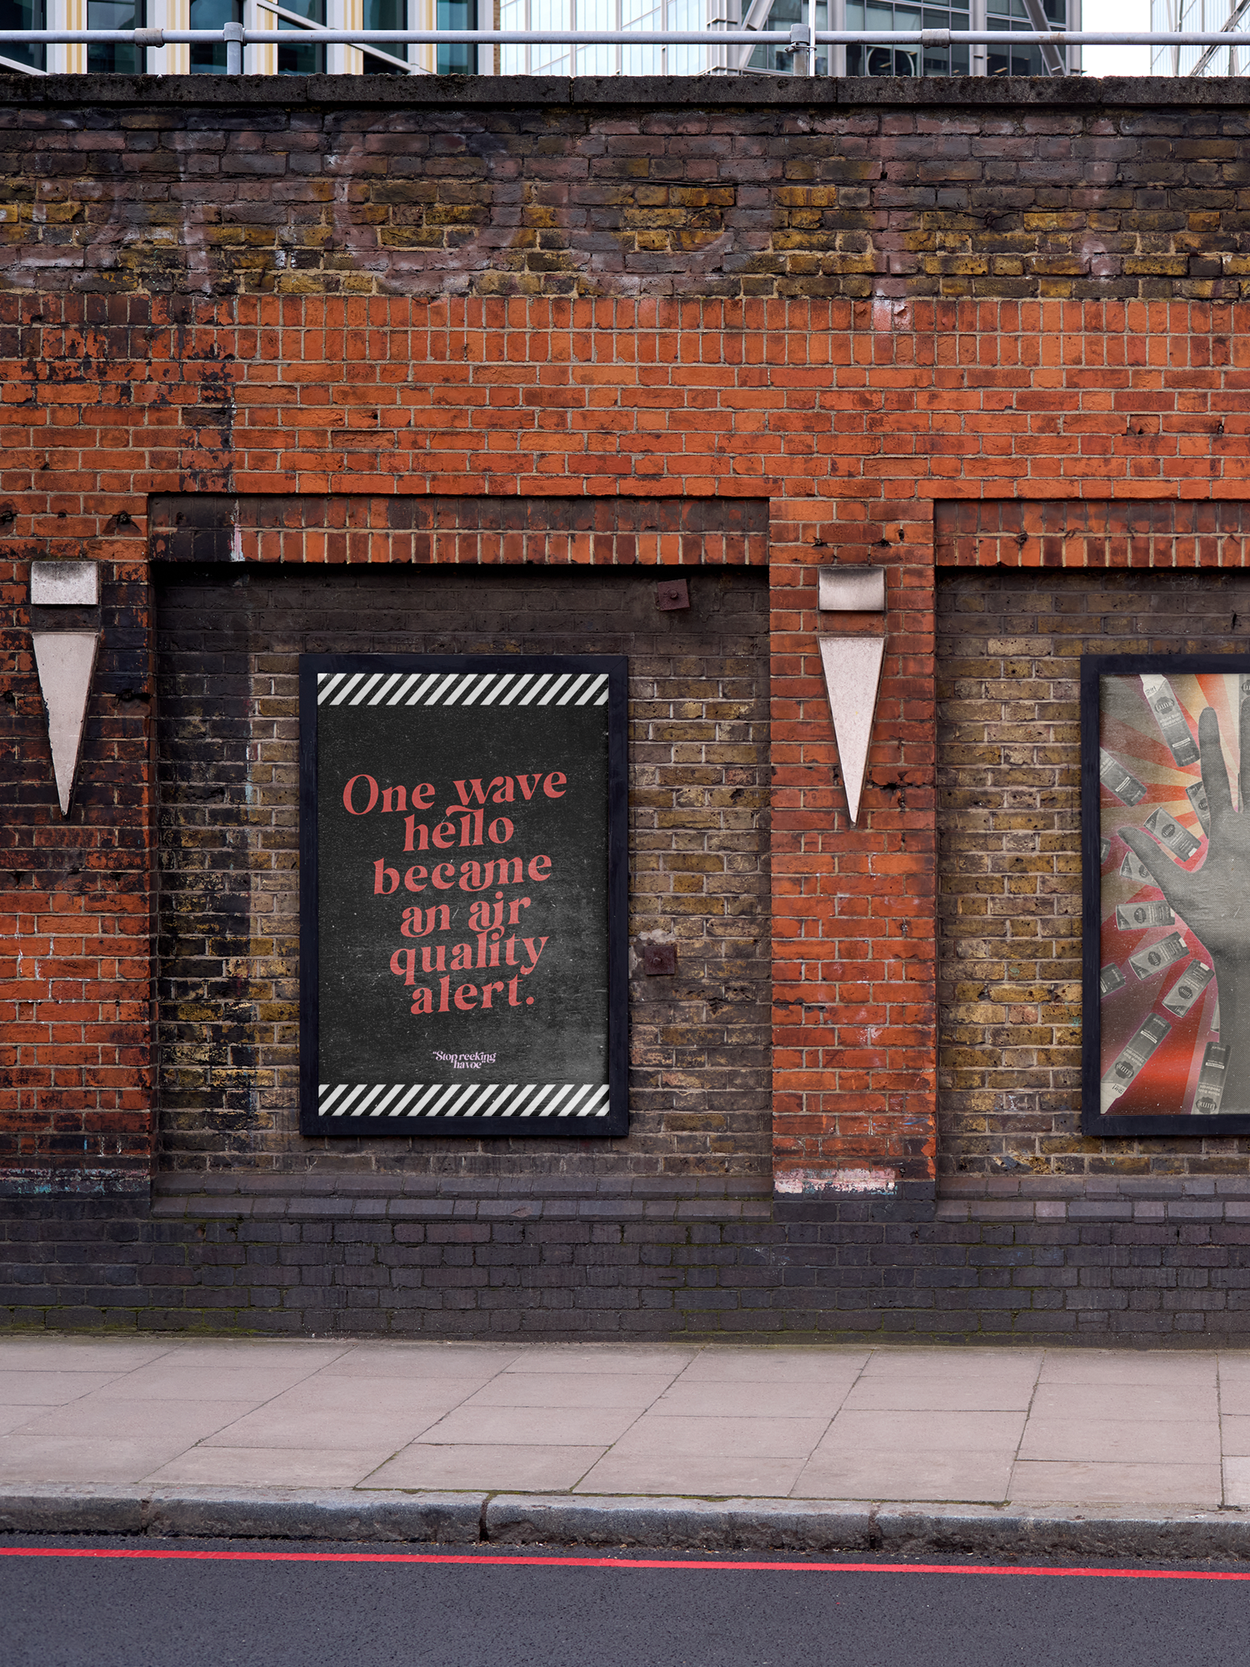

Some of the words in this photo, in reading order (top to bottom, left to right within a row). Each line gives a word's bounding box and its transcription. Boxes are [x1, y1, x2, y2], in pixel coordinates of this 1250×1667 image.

[343, 774, 435, 815] One
[453, 772, 566, 806] wave
[403, 805, 514, 851] hello
[373, 855, 551, 894] became
[401, 904, 451, 937] an
[468, 891, 531, 934] air
[390, 930, 549, 985] quality
[411, 974, 534, 1014] alert.
[459, 1052, 496, 1063] reeking
